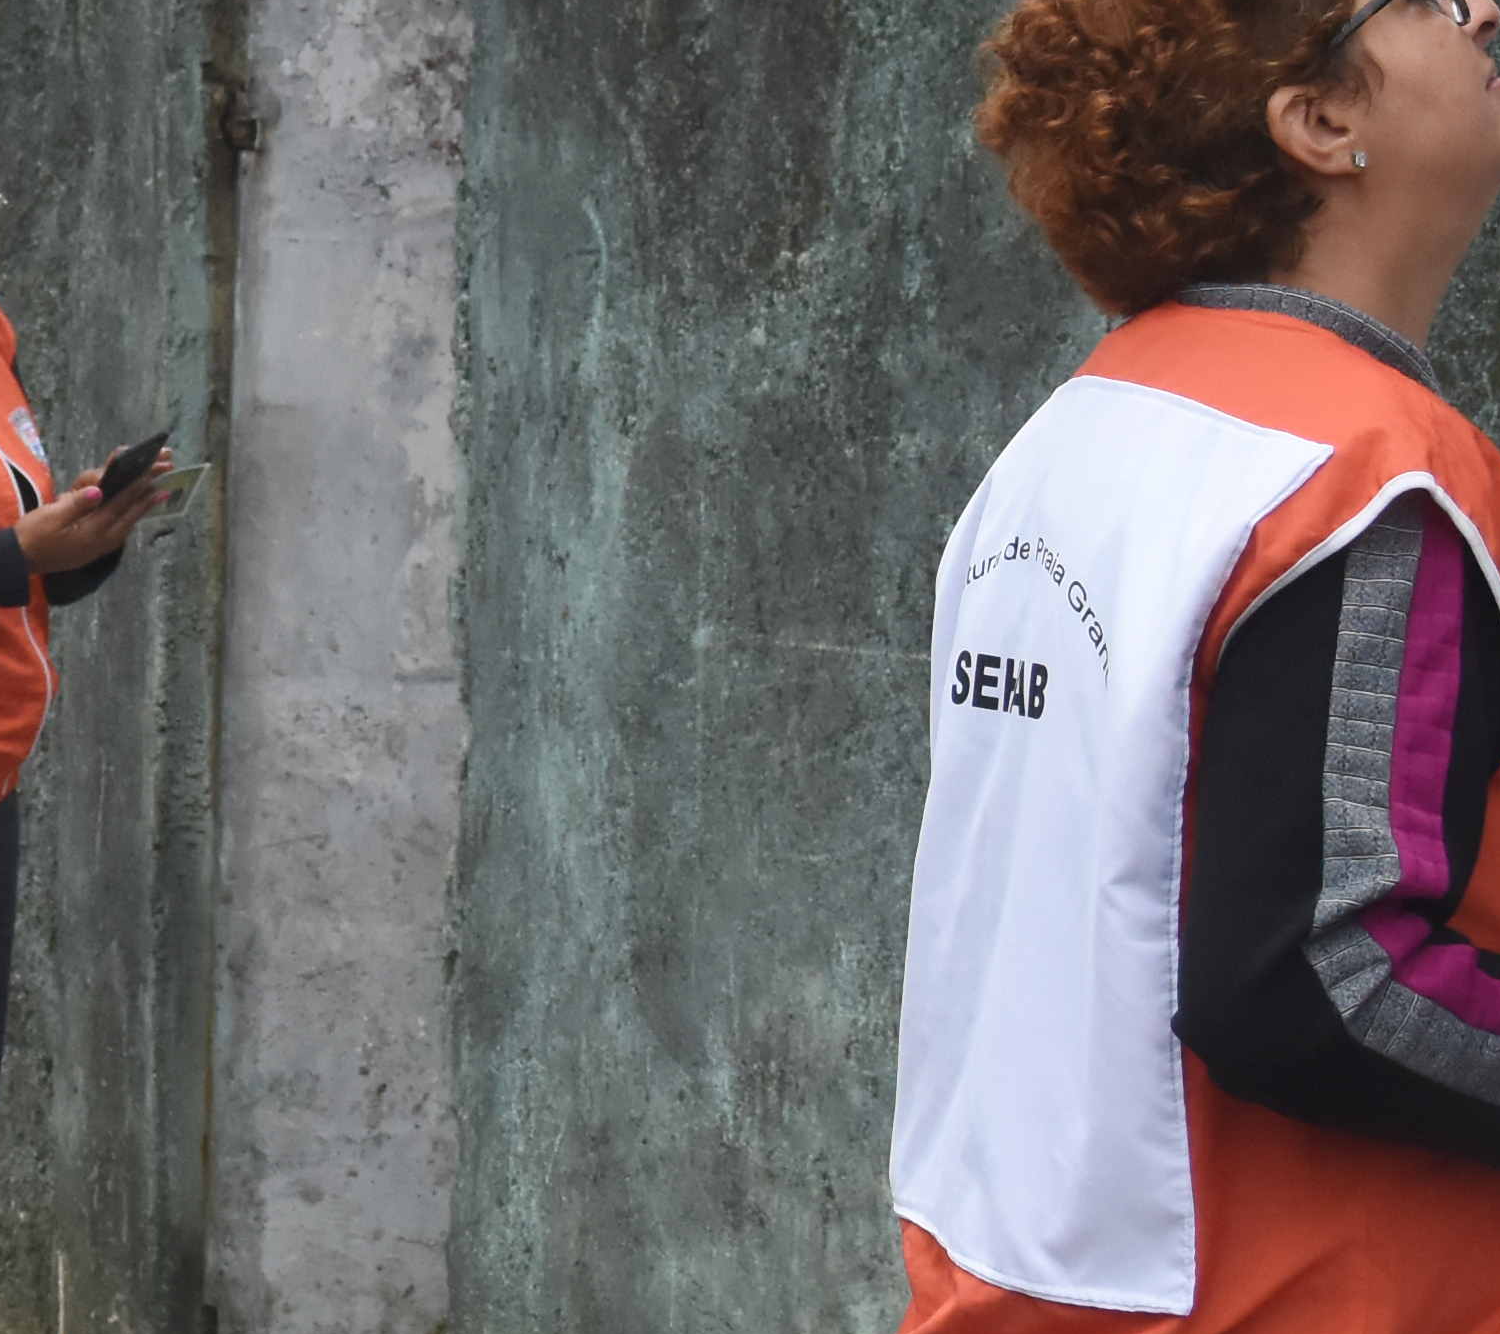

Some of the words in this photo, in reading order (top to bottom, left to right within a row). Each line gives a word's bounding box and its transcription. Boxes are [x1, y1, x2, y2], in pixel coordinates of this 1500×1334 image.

[1003, 535, 1031, 561] de
[1035, 536, 1066, 587] Praia
[1067, 580, 1110, 689] Gran
